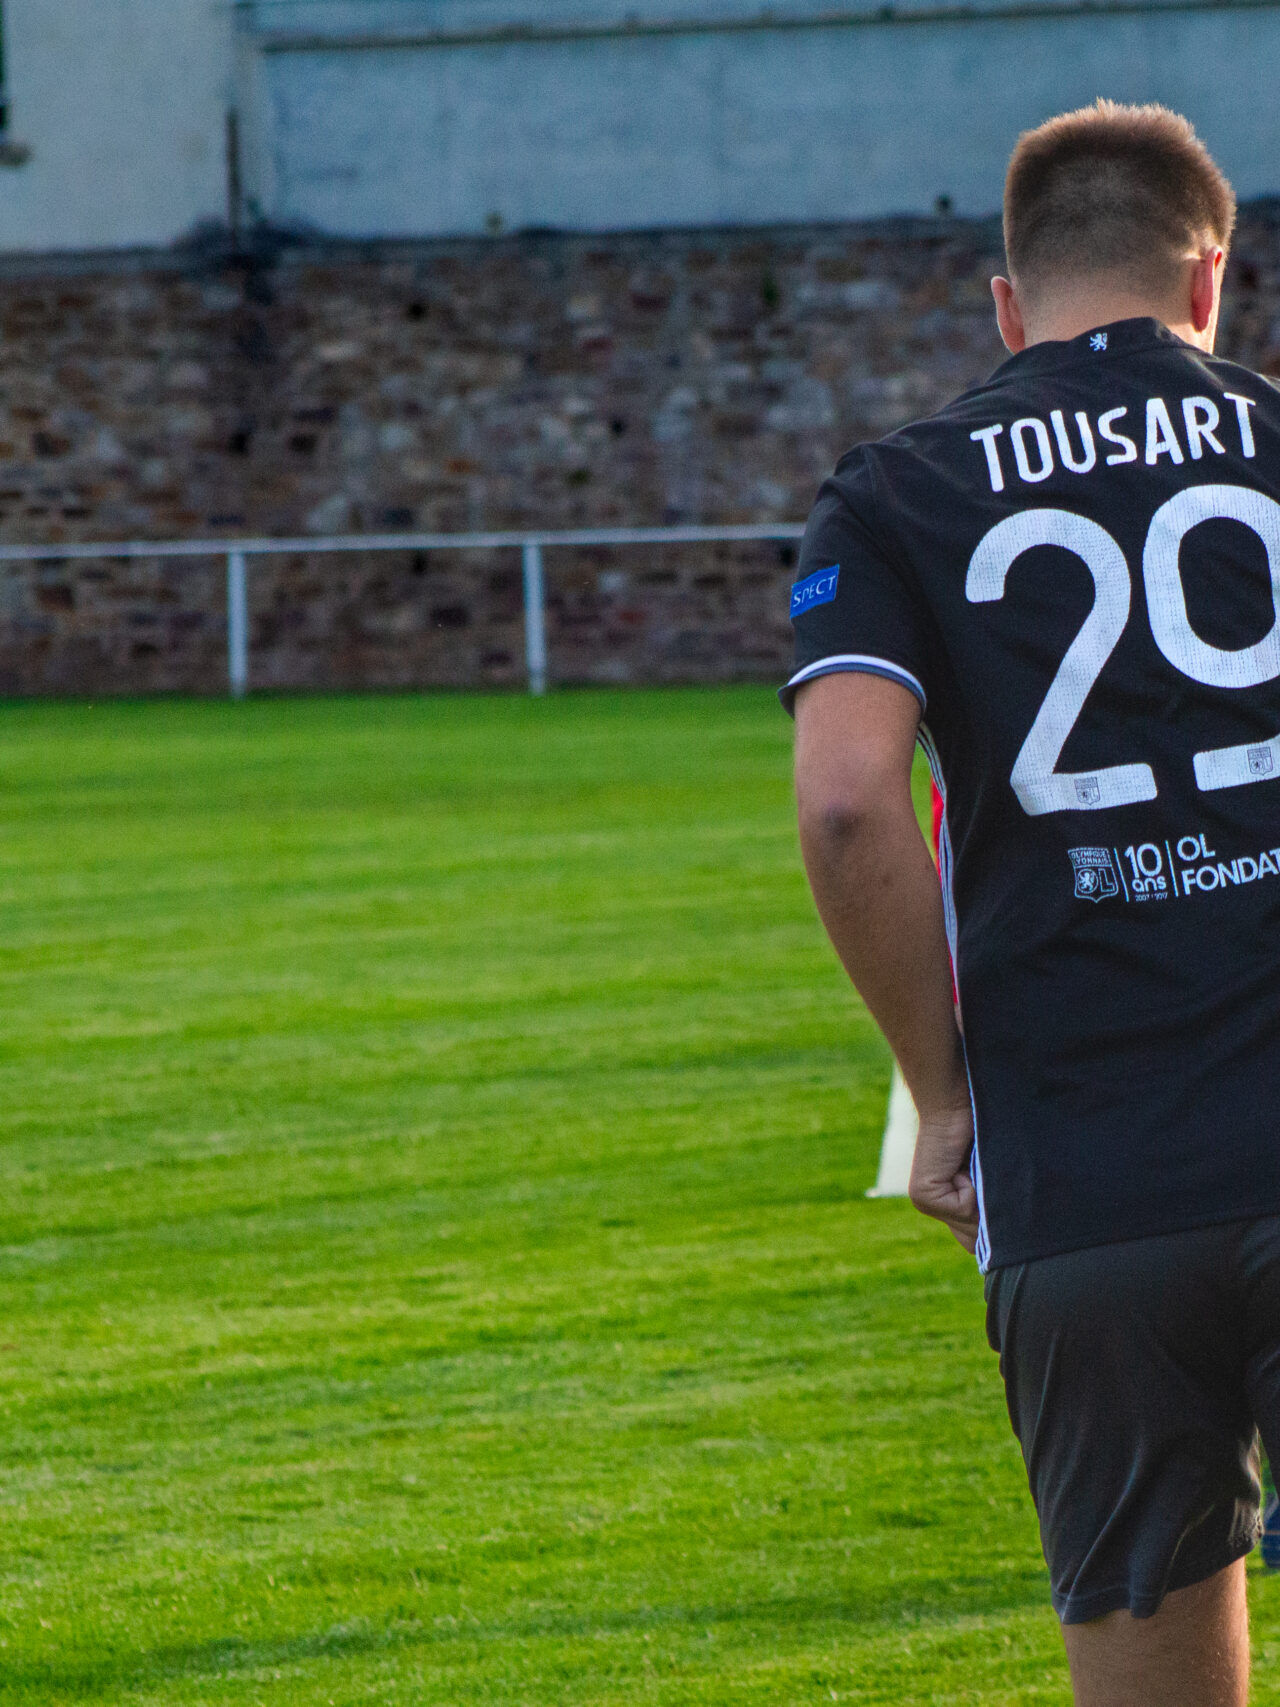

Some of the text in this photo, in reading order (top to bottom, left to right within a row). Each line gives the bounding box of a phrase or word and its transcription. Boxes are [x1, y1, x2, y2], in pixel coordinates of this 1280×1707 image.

[970, 392, 1256, 492] TOUSART
[1124, 843, 1162, 878] 10
[1176, 833, 1216, 861] OL
[1132, 876, 1167, 892] ans
